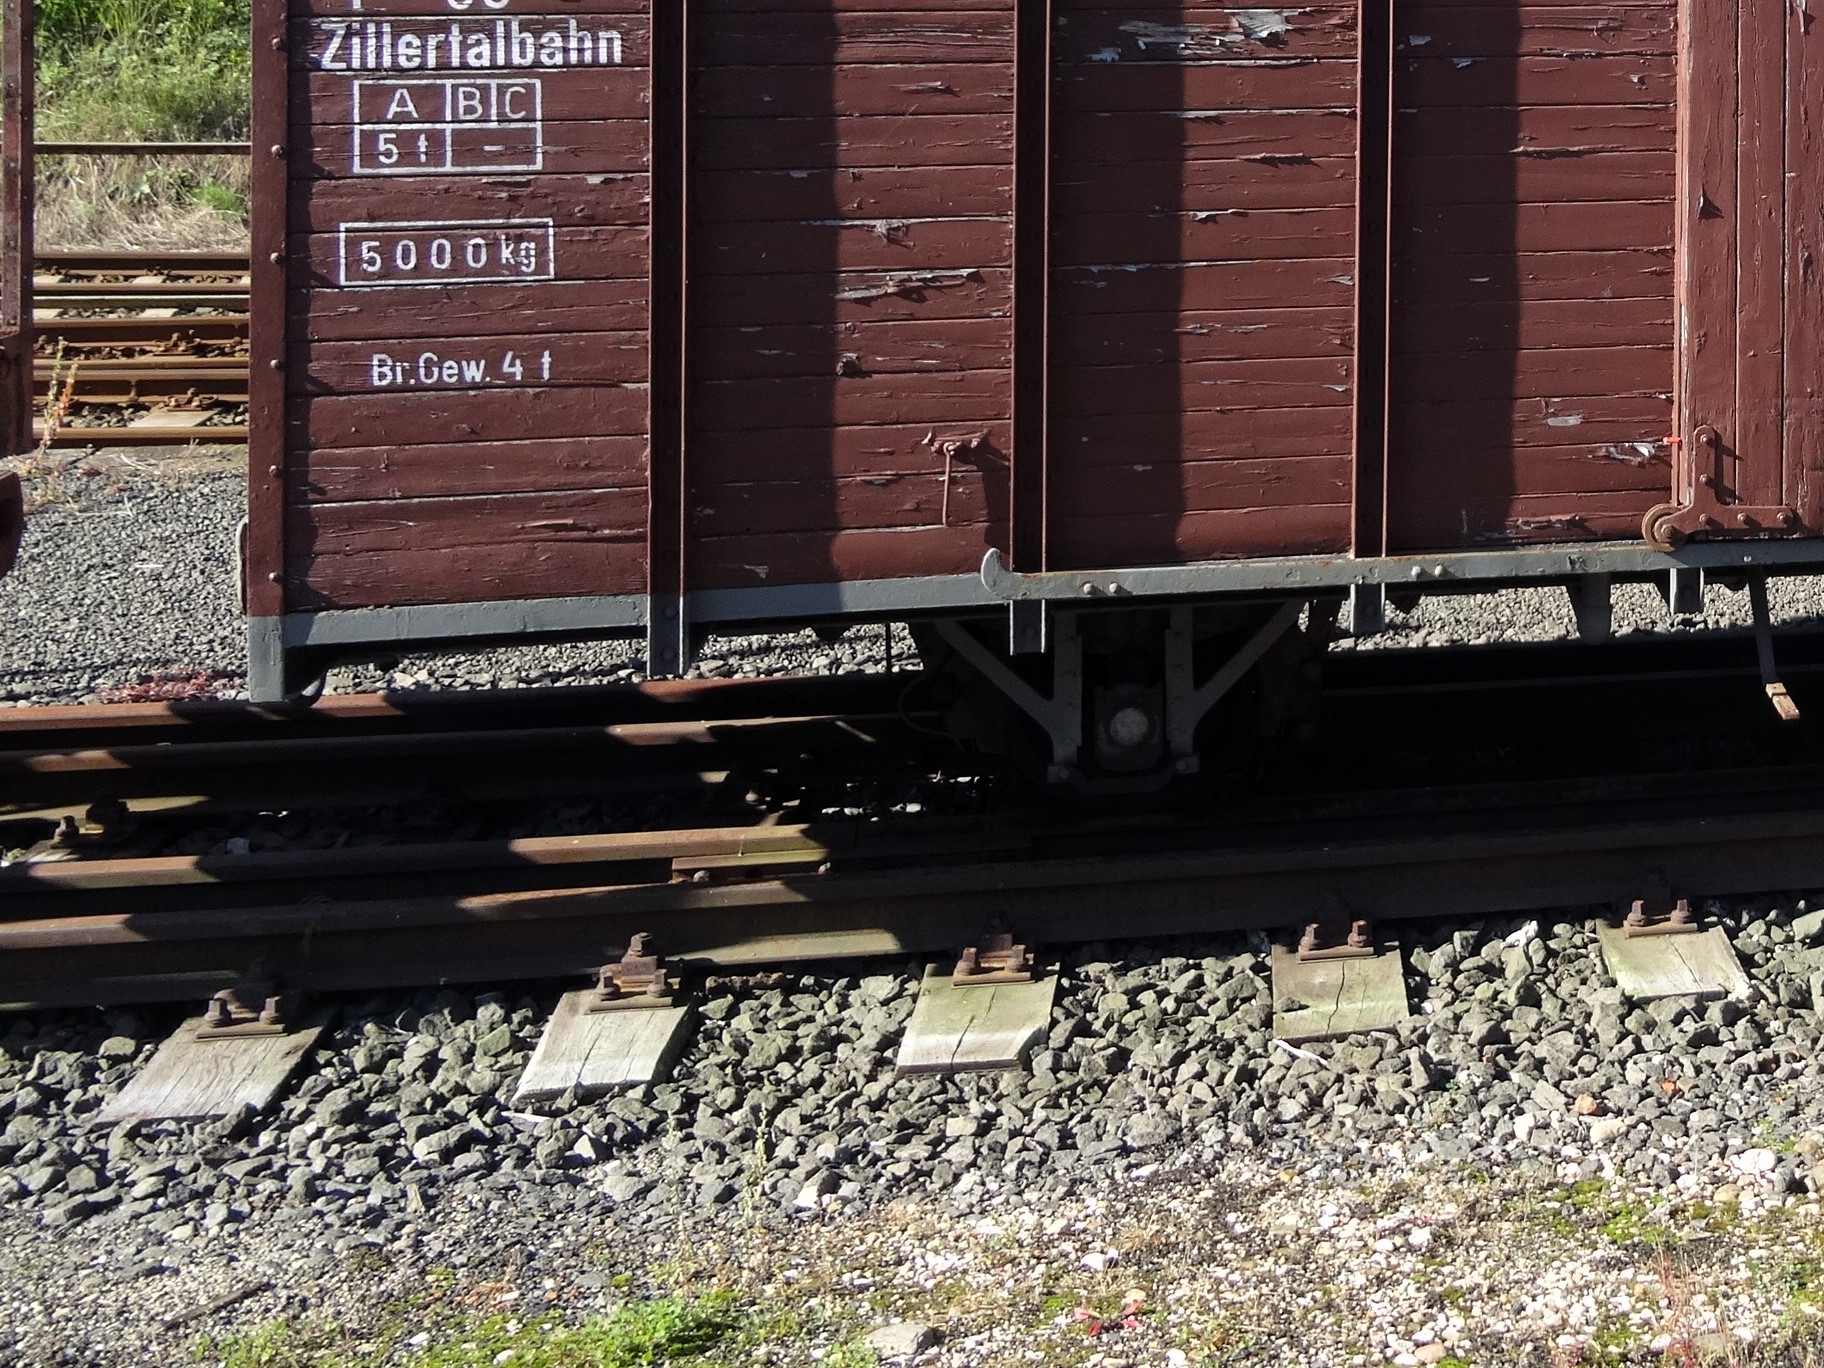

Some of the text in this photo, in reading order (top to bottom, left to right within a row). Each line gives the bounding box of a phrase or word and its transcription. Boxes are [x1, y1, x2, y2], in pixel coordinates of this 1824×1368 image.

[320, 19, 623, 70] Zillertalbahn
[386, 86, 527, 120] A B C
[378, 133, 399, 164] 5
[502, 350, 524, 381] 4
